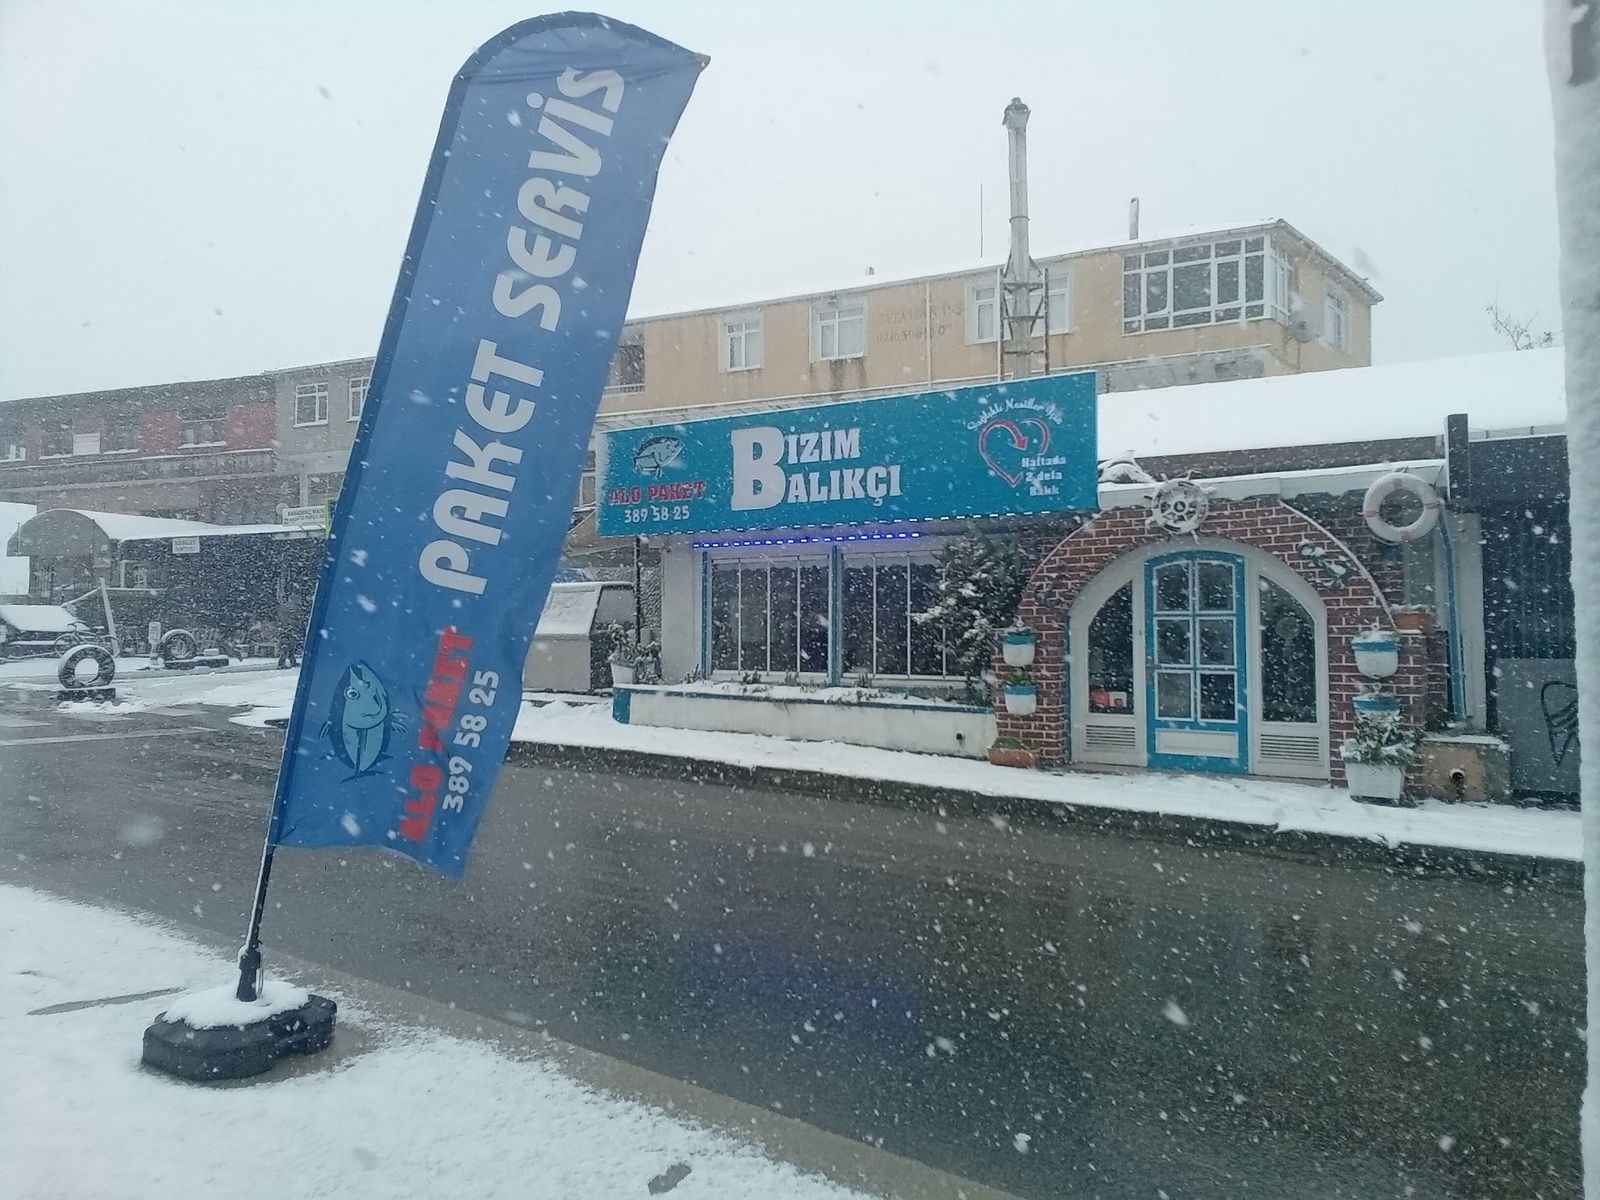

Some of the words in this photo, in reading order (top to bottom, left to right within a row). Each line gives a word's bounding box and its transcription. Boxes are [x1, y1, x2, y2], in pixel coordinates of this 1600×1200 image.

[418, 338, 545, 595] PAKET
[492, 66, 625, 332] SERVİS
[1021, 455, 1067, 468] Haftada
[1025, 471, 1034, 482] 2
[1037, 469, 1063, 481] defa
[609, 486, 642, 506] ALO
[648, 480, 707, 503] PAKET
[624, 507, 648, 523] 389
[652, 505, 669, 521] 58
[673, 505, 690, 520] 25
[418, 625, 474, 752] PAKET
[468, 670, 500, 707] 25
[453, 714, 488, 748] 58
[442, 756, 473, 813] 389
[400, 764, 443, 841] ALO
